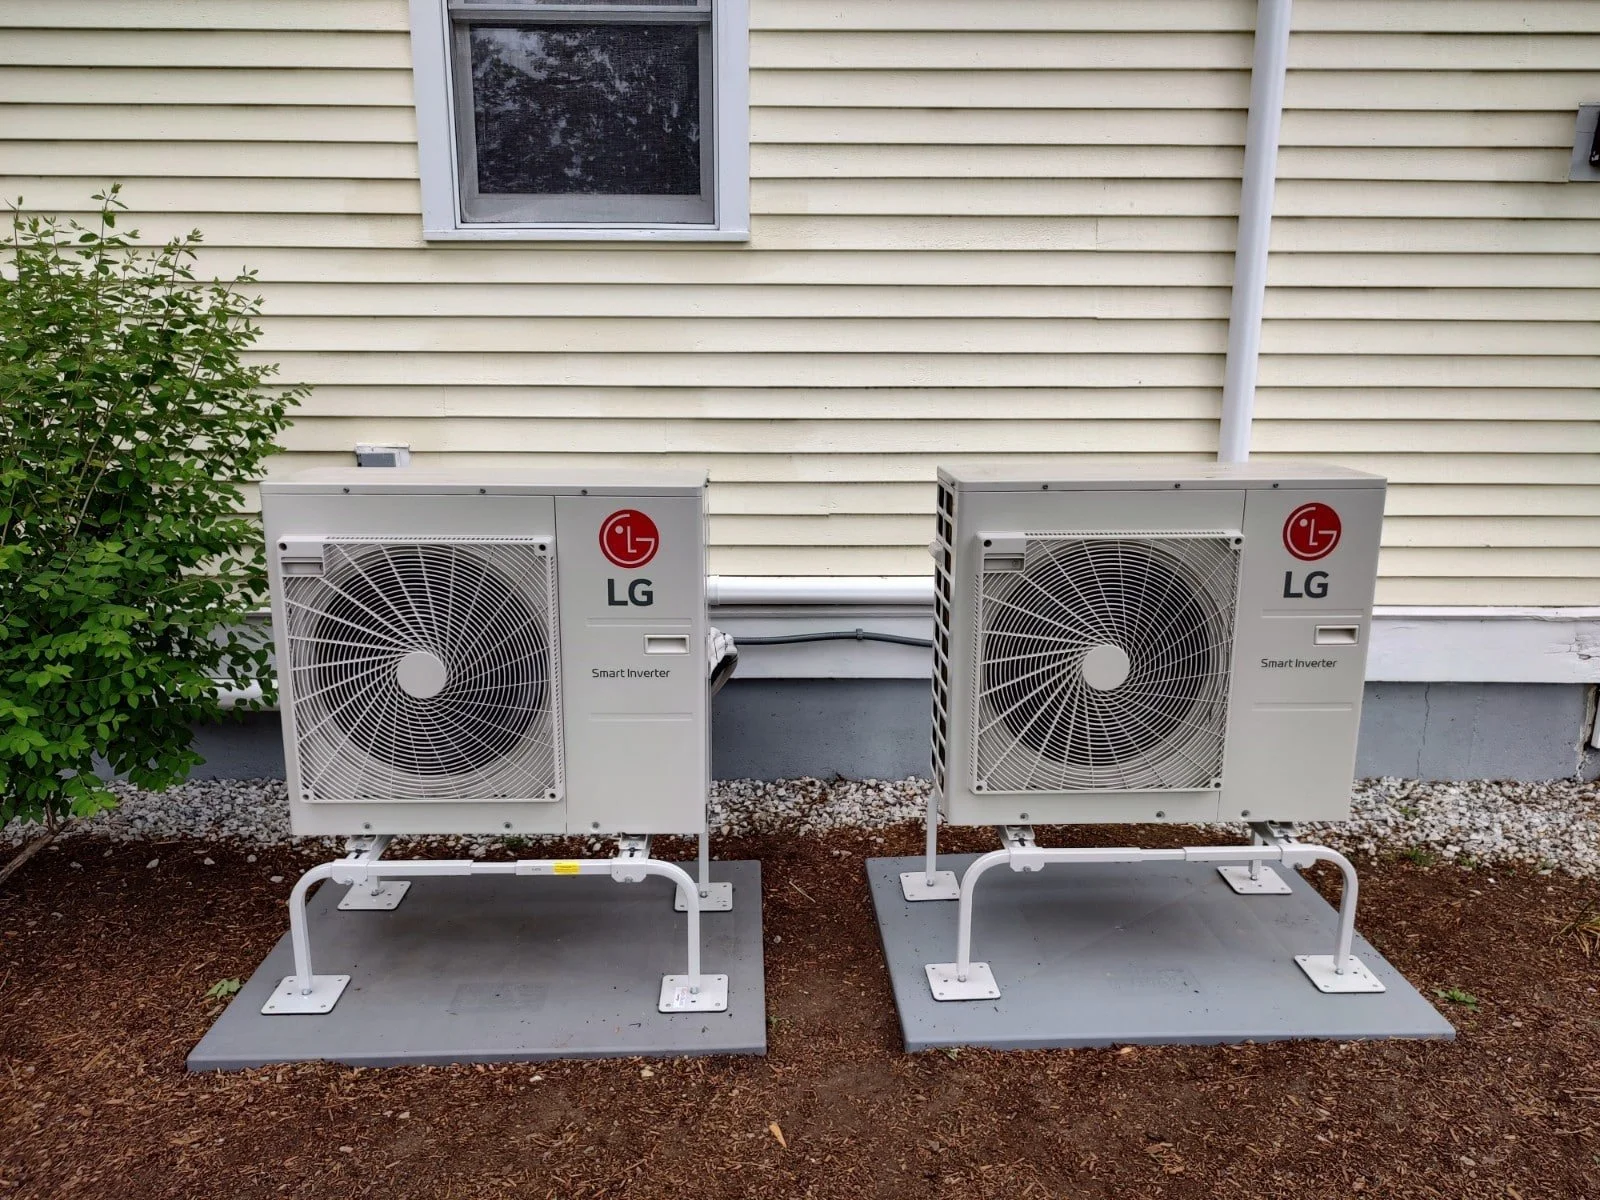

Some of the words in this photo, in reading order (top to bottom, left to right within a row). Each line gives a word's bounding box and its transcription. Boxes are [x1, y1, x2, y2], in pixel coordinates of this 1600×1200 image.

[607, 578, 654, 607] LG
[1282, 570, 1330, 599] LG
[1260, 658, 1294, 668] Smart
[1295, 658, 1338, 668] Inverter
[591, 668, 626, 678] Smart
[627, 668, 671, 678] Inverter
